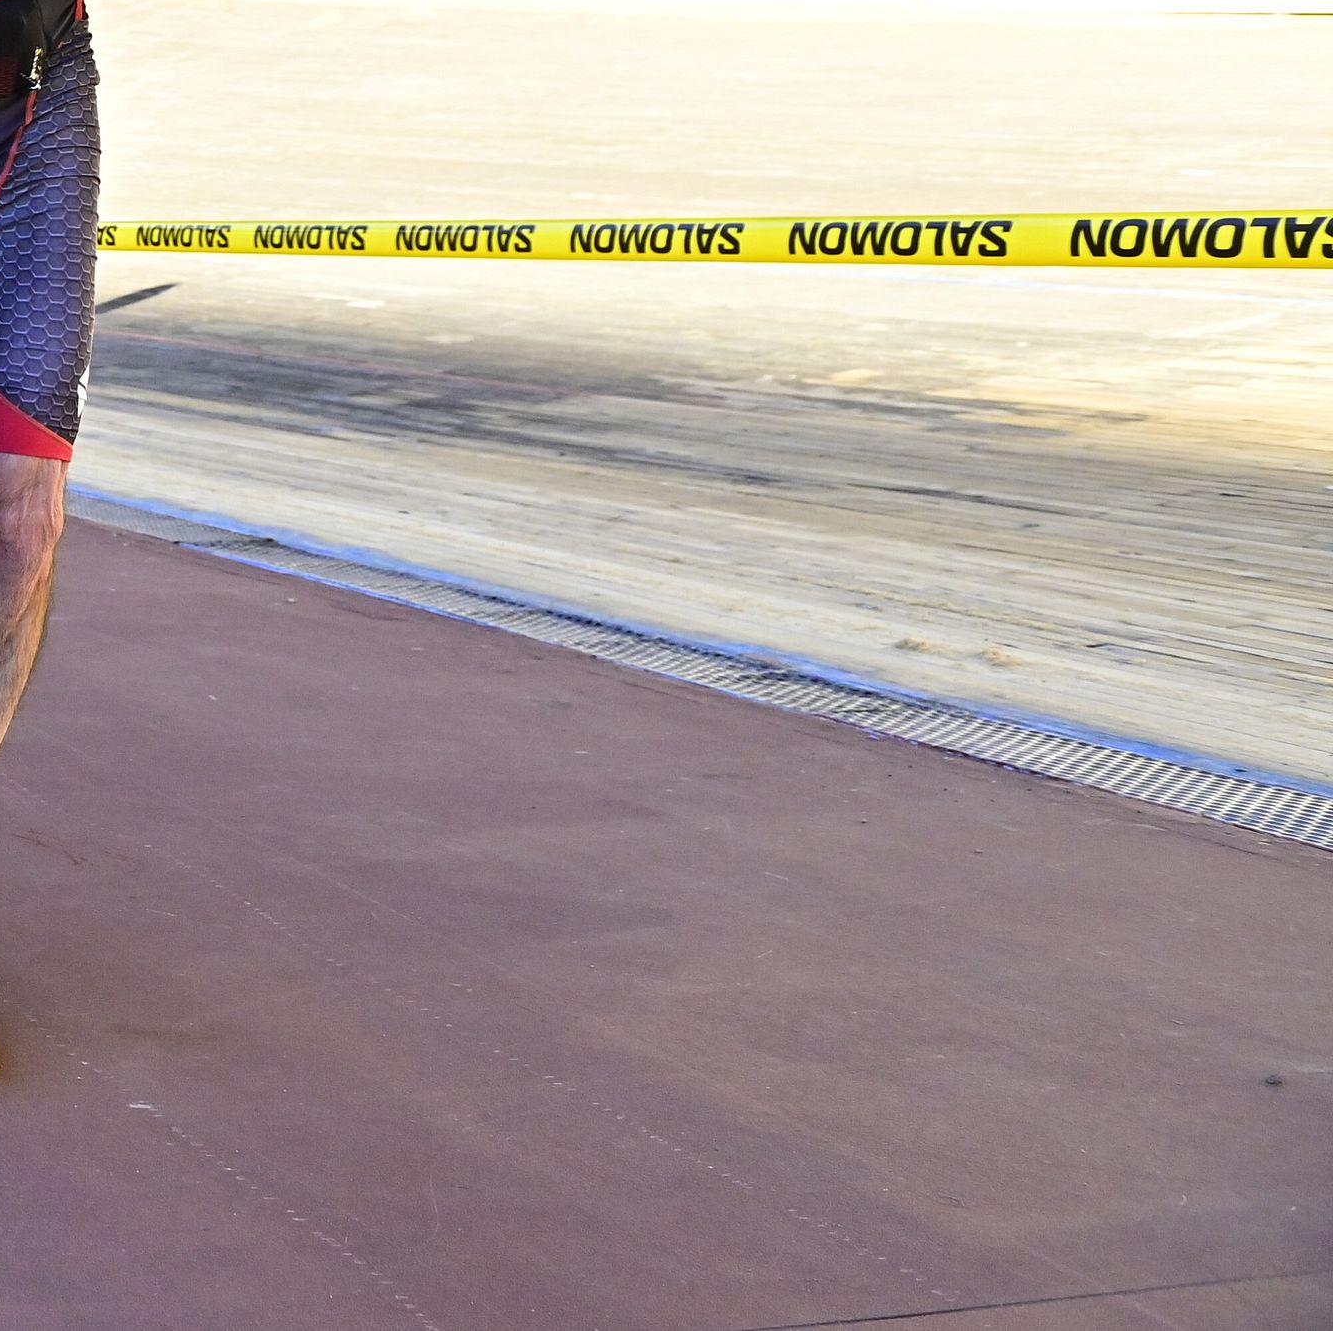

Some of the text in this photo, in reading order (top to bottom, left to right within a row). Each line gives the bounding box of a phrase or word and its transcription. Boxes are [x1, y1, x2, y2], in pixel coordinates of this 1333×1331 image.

[136, 224, 231, 249] SALOMON
[254, 224, 367, 251] SALOMON
[395, 223, 534, 253] SALOMON
[569, 222, 746, 255] SALOMON
[788, 220, 1013, 257] SALOMON
